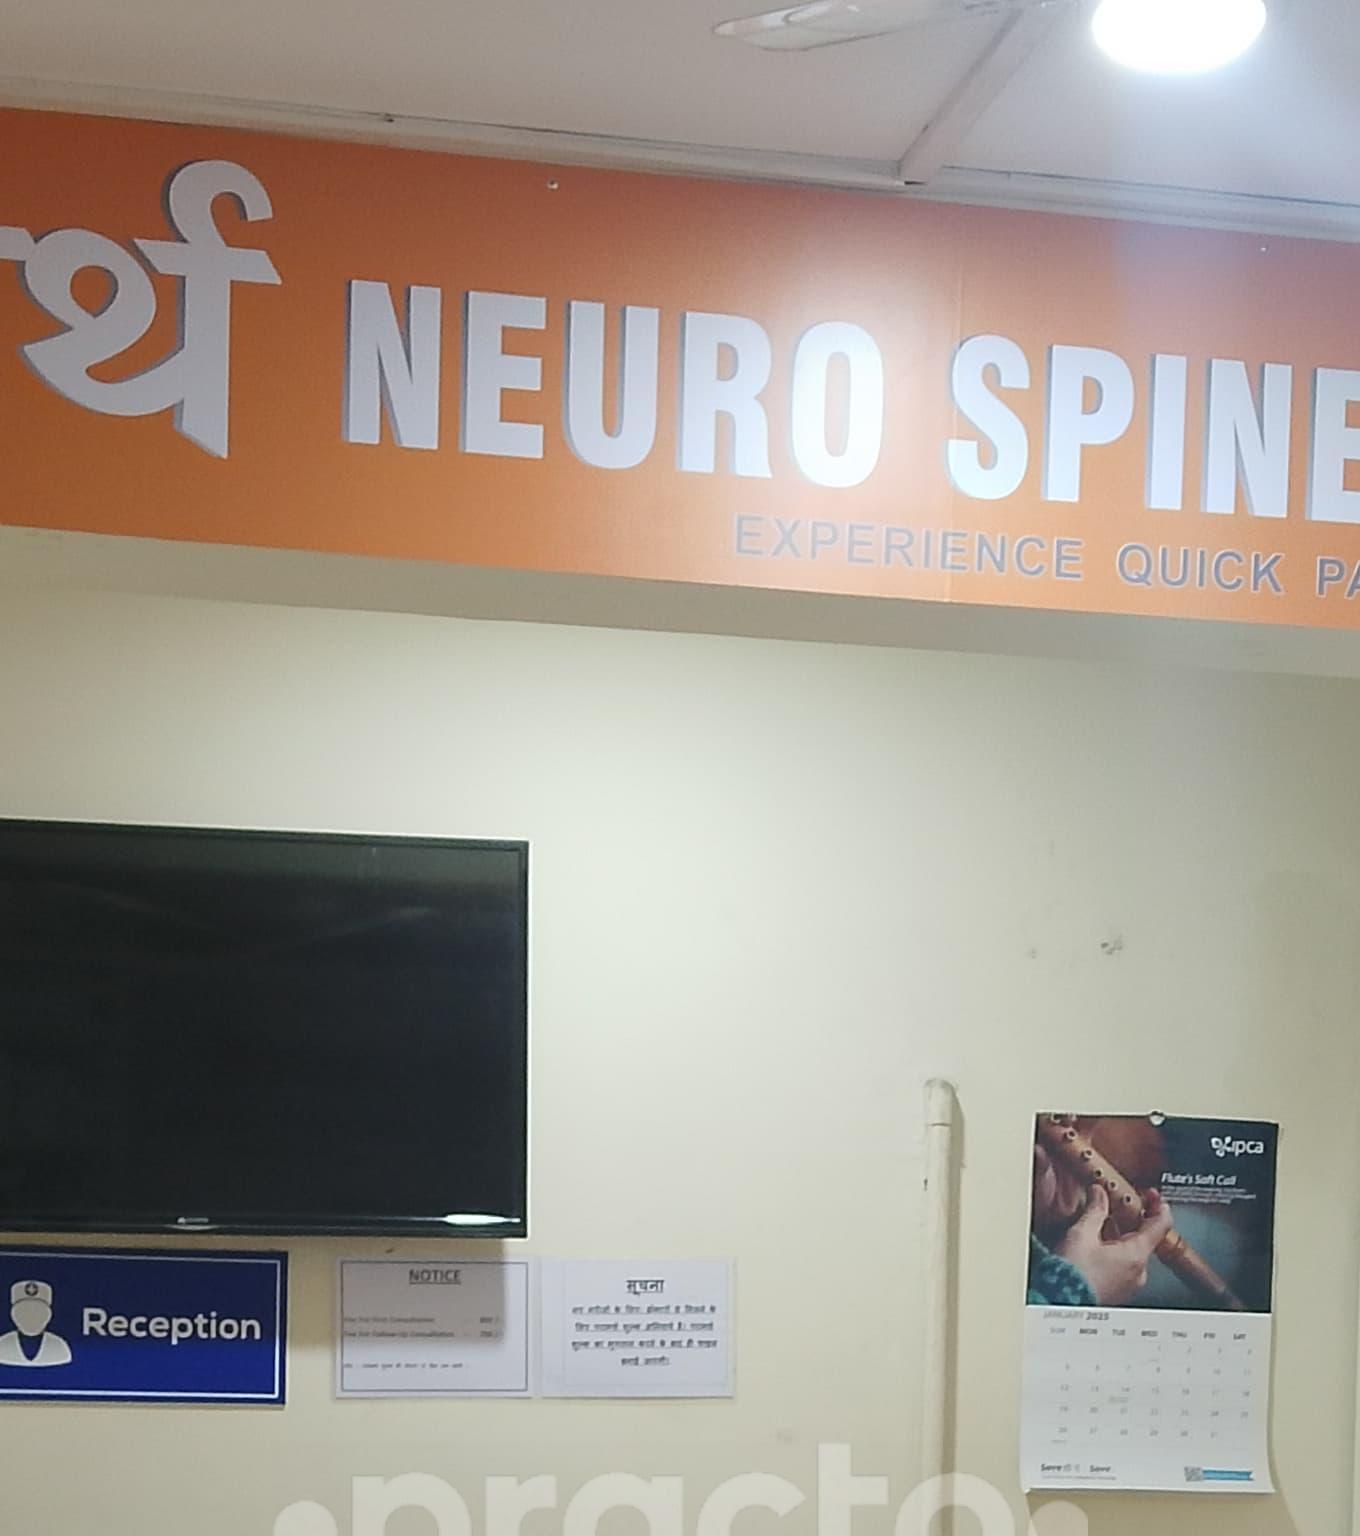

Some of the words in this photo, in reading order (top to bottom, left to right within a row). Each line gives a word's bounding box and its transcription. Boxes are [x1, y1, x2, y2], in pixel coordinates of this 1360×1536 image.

[343, 279, 885, 489] NEURO
[734, 513, 1085, 581] EXPERIENCE
[1115, 541, 1284, 595] QUICK
[1195, 1173, 1214, 1185] Soft
[408, 1269, 462, 1285] NOTICE
[626, 1278, 666, 1297] सूचना
[82, 1306, 262, 1345] Reception
